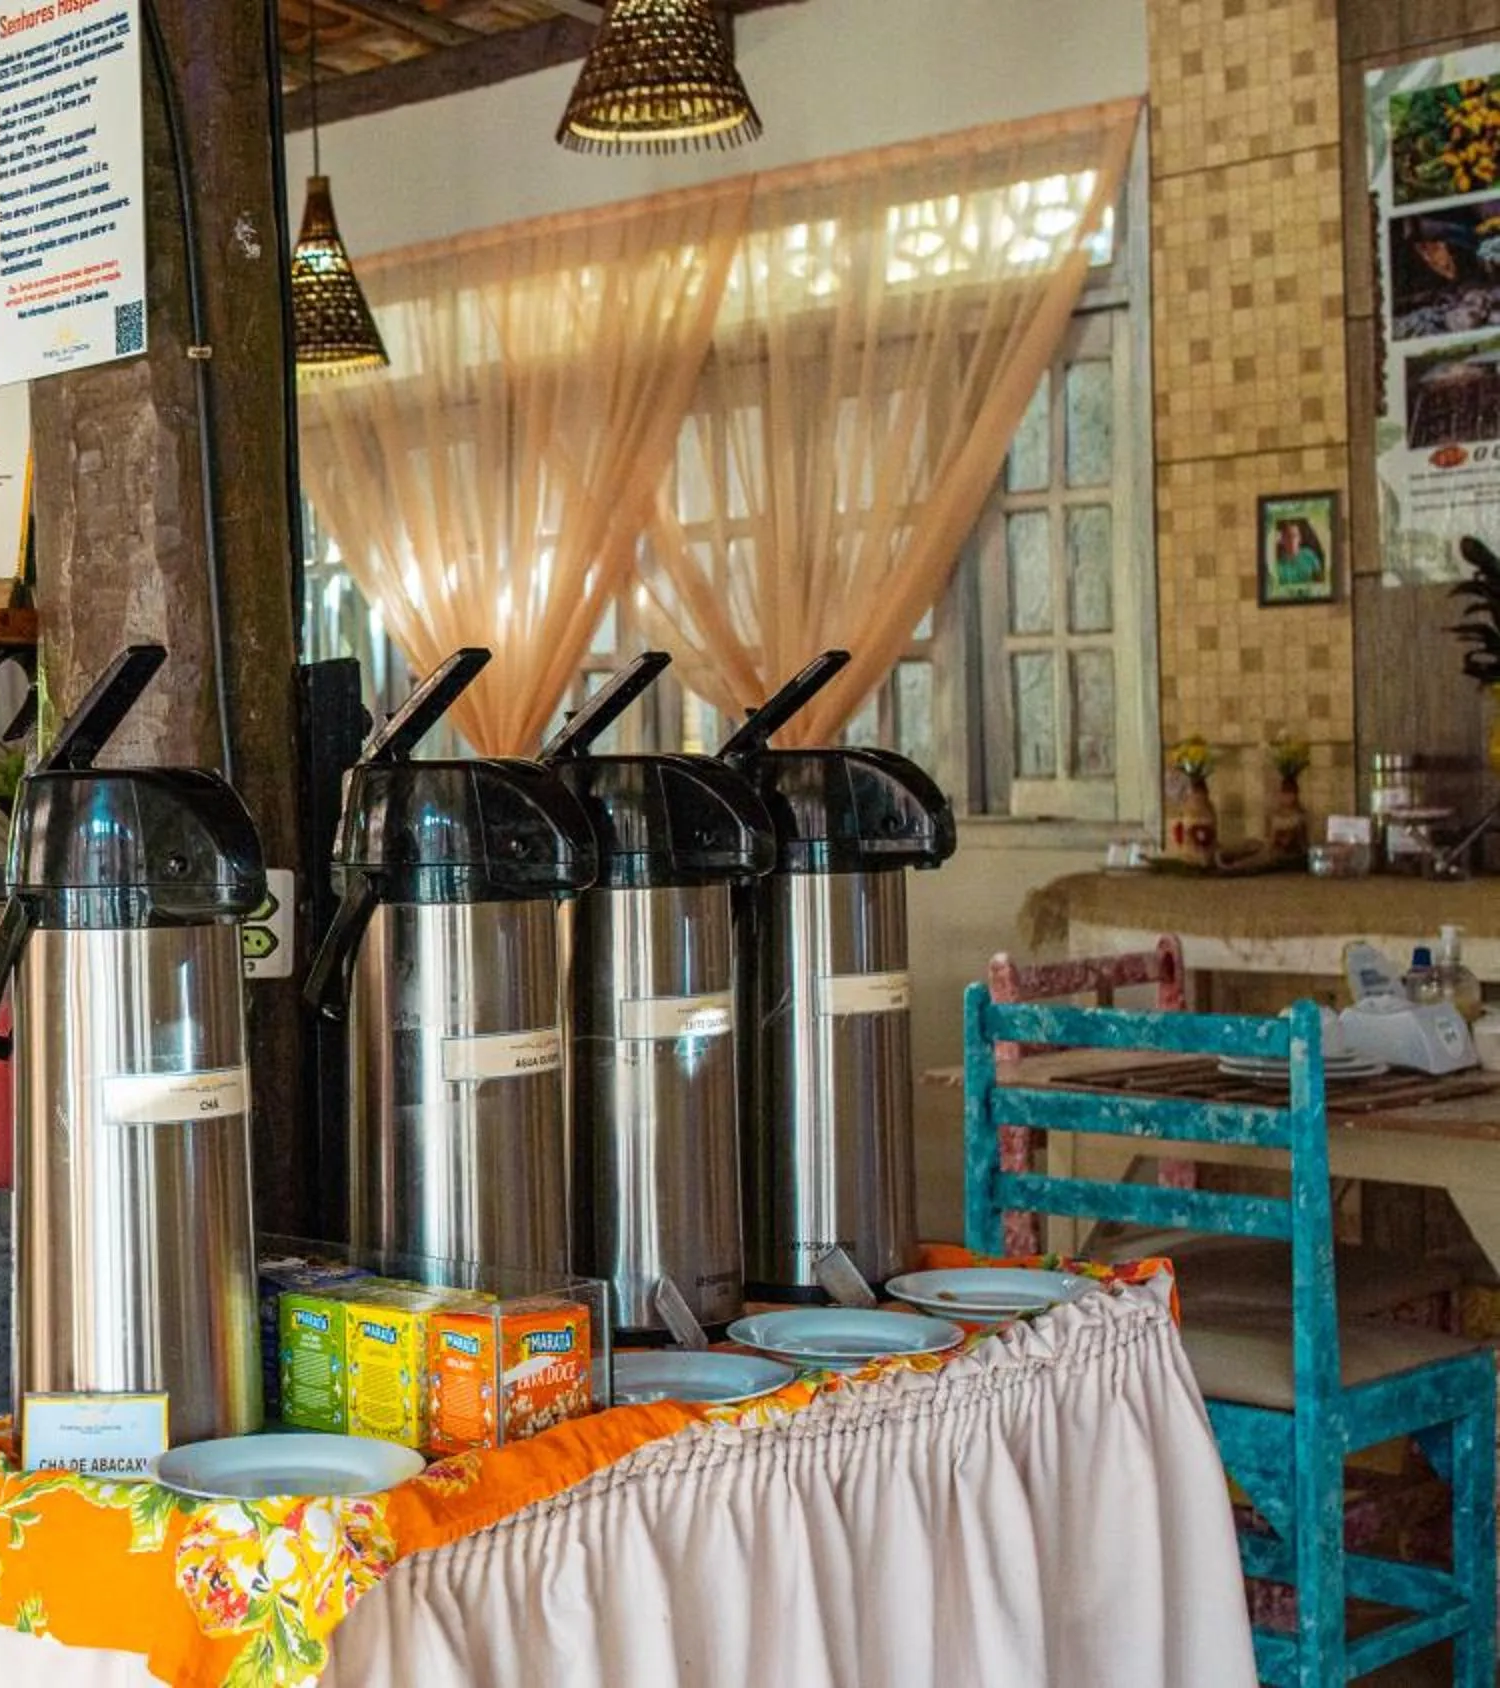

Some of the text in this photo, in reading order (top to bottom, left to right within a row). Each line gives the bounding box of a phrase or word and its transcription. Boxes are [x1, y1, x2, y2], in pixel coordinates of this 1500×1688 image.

[0, 5, 54, 38] Senhores
[548, 1360, 577, 1386] DOCE
[71, 1458, 88, 1473] DE
